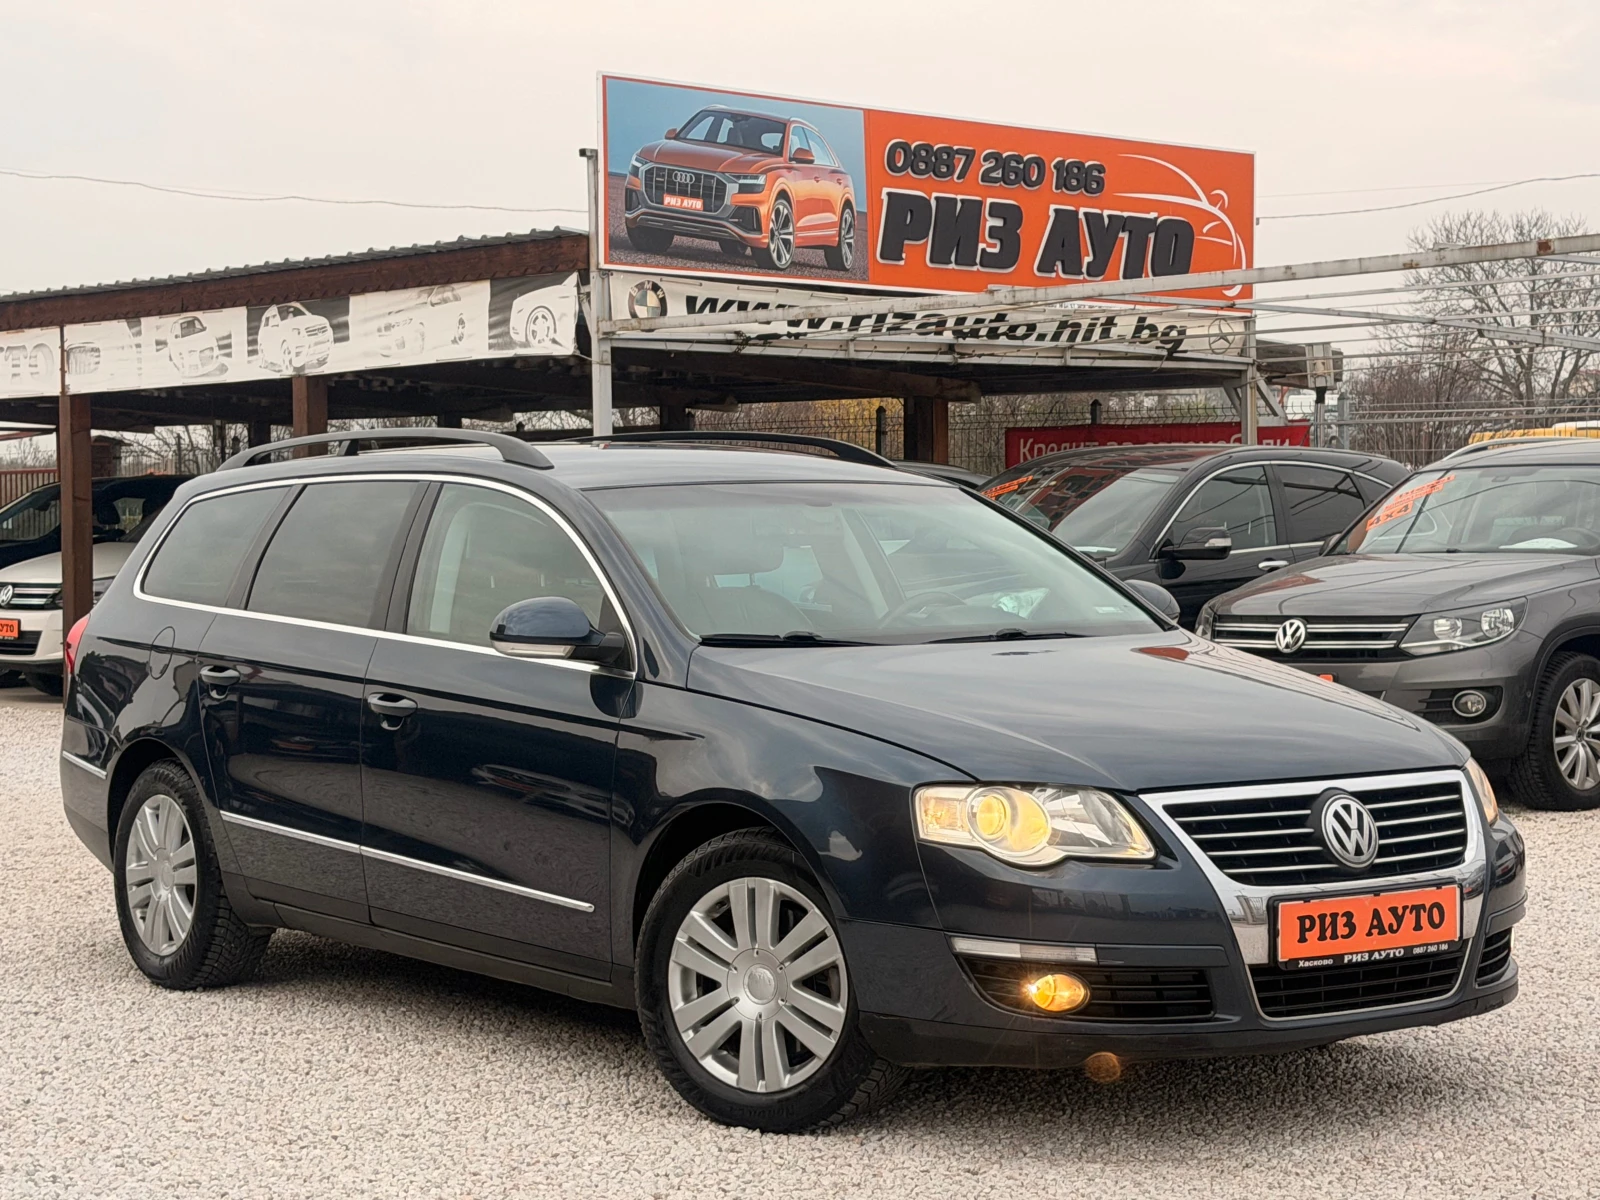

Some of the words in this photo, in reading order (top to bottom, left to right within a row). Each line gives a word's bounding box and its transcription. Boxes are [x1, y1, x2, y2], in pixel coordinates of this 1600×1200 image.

[885, 139, 976, 183] 0887
[979, 150, 1046, 190] 260
[1051, 157, 1106, 195] 186
[665, 197, 681, 205] РИЗ
[682, 199, 702, 208] АУТО
[877, 187, 1023, 272] РИЗ
[1034, 204, 1194, 280] АУТО
[1323, 795, 1377, 866] VW
[1297, 911, 1356, 944] РИЗ
[1365, 901, 1446, 937] АУТО
[1298, 958, 1334, 968] Хасково
[1343, 953, 1369, 964] РИЗ
[1371, 948, 1405, 961] АУТО
